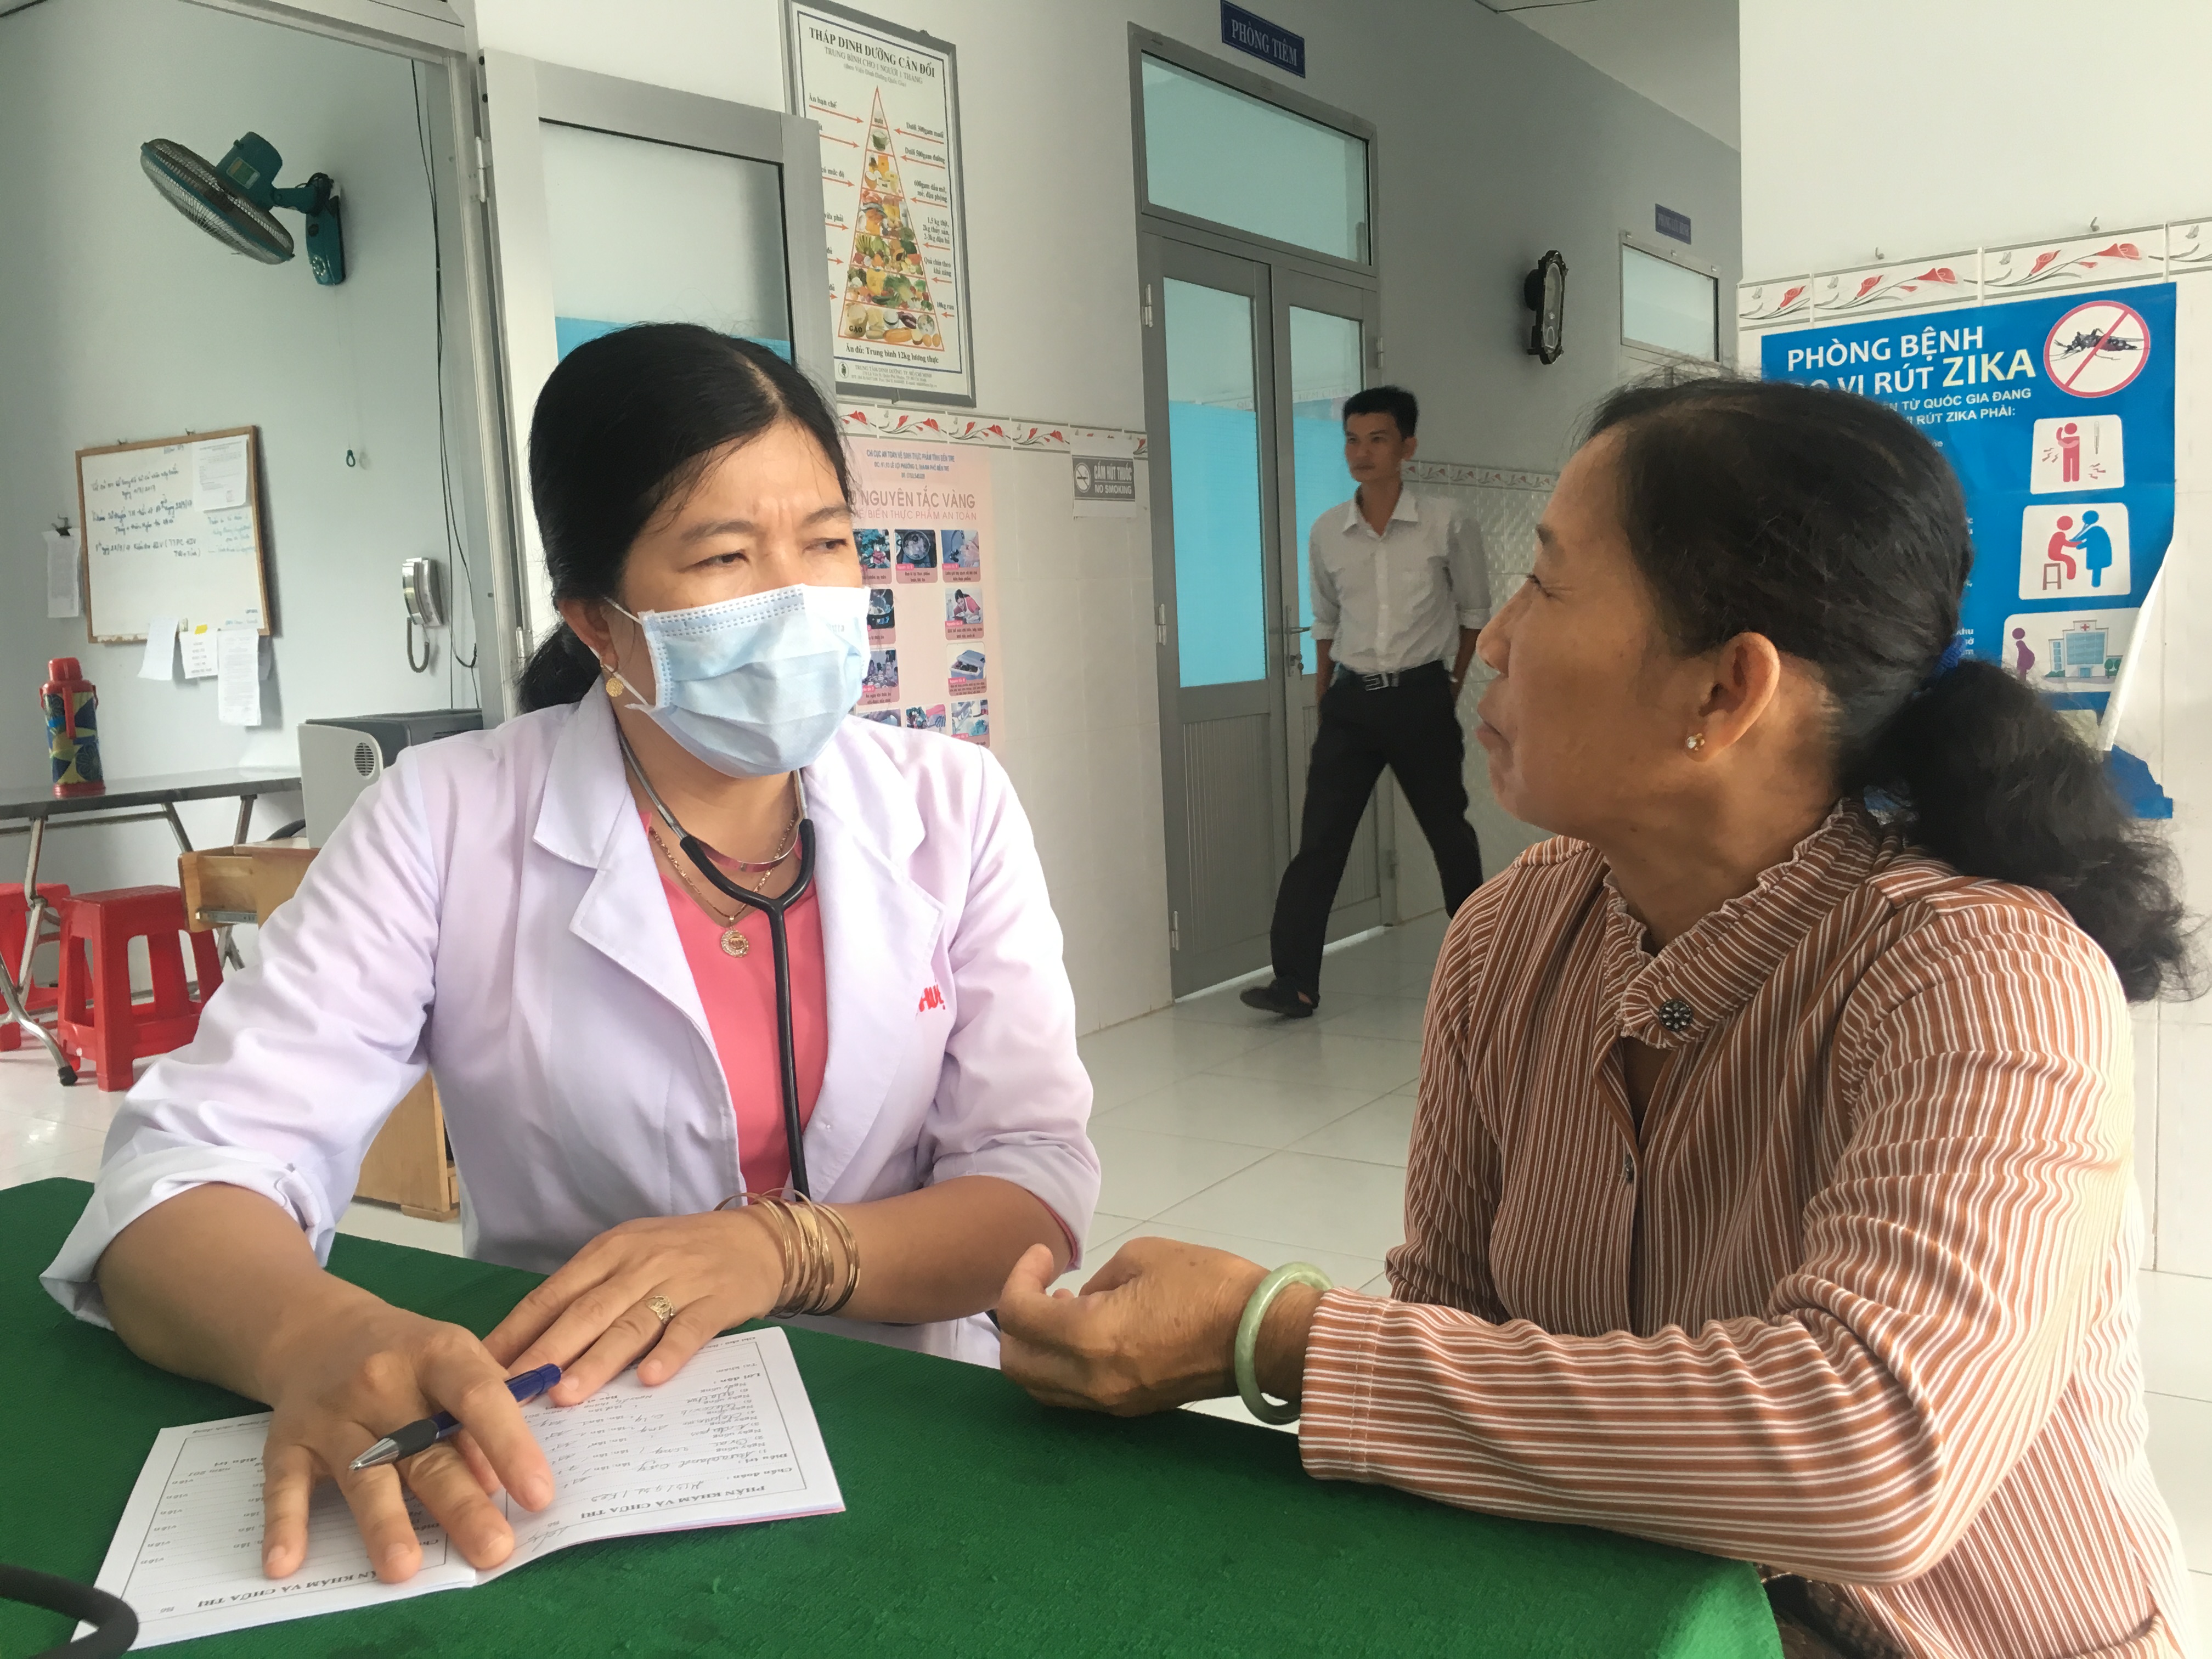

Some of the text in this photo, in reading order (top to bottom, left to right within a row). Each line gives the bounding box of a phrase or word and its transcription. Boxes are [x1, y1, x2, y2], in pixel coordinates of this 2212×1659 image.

[1231, 19, 1297, 66] PHÒNG TIÊM
[809, 27, 935, 77] THÁP DINH DƯỠNG CÂN ĐỐI
[825, 47, 845, 59] TRUNG
[847, 53, 862, 65] BÌNH
[862, 59, 876, 68] CHO
[881, 65, 898, 76] NGƯỜI
[903, 72, 923, 84] THÁNG
[817, 97, 827, 105] hạn
[839, 170, 844, 178] độ
[934, 218, 940, 227] kg
[849, 325, 862, 333] GẠO
[846, 343, 939, 364] Ăn đủ: Trung bình 12kg lương thực
[1788, 326, 1983, 371] PHÒNG BỆNH
[1875, 363, 1934, 395] RÚT
[1942, 349, 2036, 387] ZIKA
[1901, 398, 1920, 410] TỪ
[1923, 394, 1962, 409] QUỐC
[1966, 393, 1989, 405] GIA
[1992, 388, 2032, 402] ĐANG
[1916, 404, 2016, 425] RÚT ZIKA PHẢI:
[1094, 460, 1106, 479] CẤM
[1095, 484, 1132, 494] NO SMOKING
[861, 487, 914, 507] NGUYÊN
[916, 485, 939, 508] TẮC
[942, 489, 975, 509] VÀNG
[868, 507, 976, 520] BIẾN THỰC PHẨM AN TOÀN
[679, 1492, 721, 1503] KHÁM
[580, 1509, 606, 1519] TRỊ
[610, 1503, 651, 1513] CHỮA
[280, 1583, 301, 1594] VÀ
[306, 1575, 354, 1589] KHÁM
[230, 1588, 275, 1601] CHỮA
[198, 1596, 225, 1607] TRỊ
